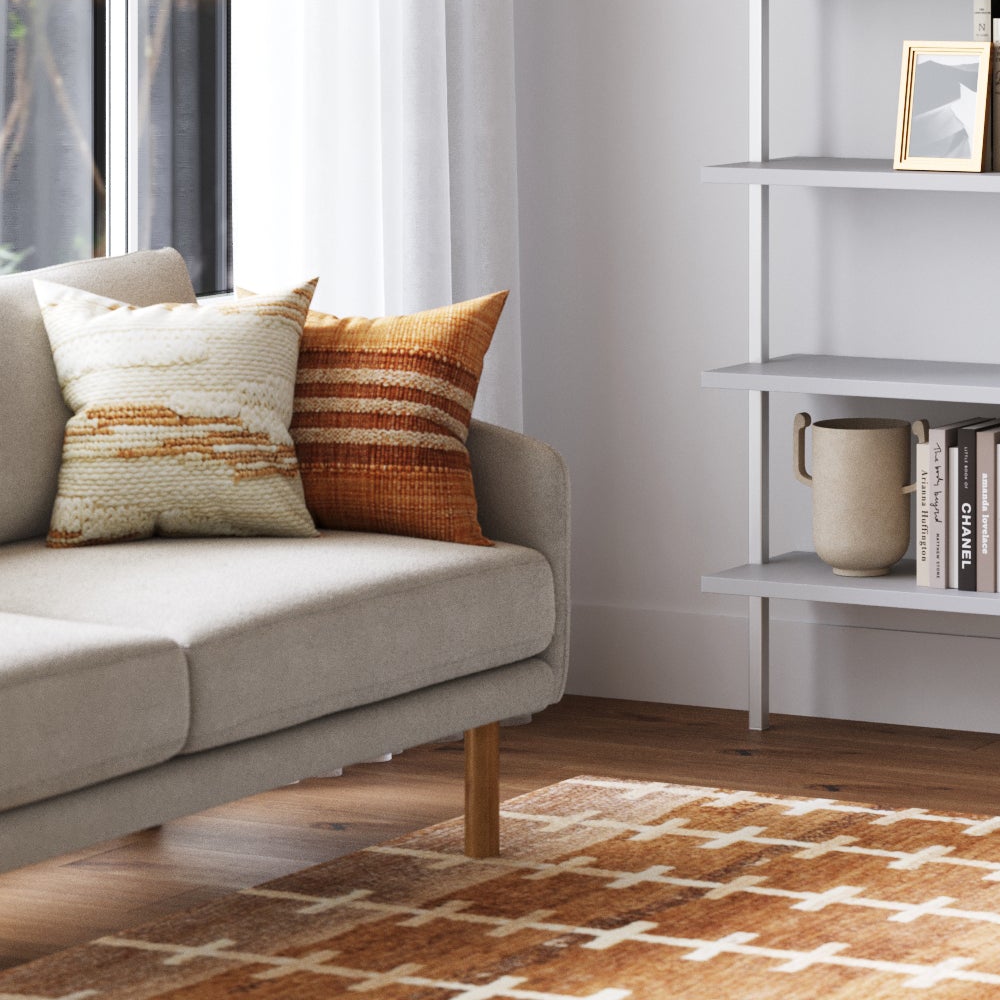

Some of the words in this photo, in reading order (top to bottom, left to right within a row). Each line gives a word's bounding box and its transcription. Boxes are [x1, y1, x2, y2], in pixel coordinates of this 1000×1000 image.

[978, 23, 986, 32] N
[933, 442, 941, 462] The
[933, 465, 943, 486] body
[964, 481, 968, 489] OF
[930, 491, 942, 523] beyond
[919, 510, 928, 561] Huffington
[961, 502, 971, 569] CHANEL
